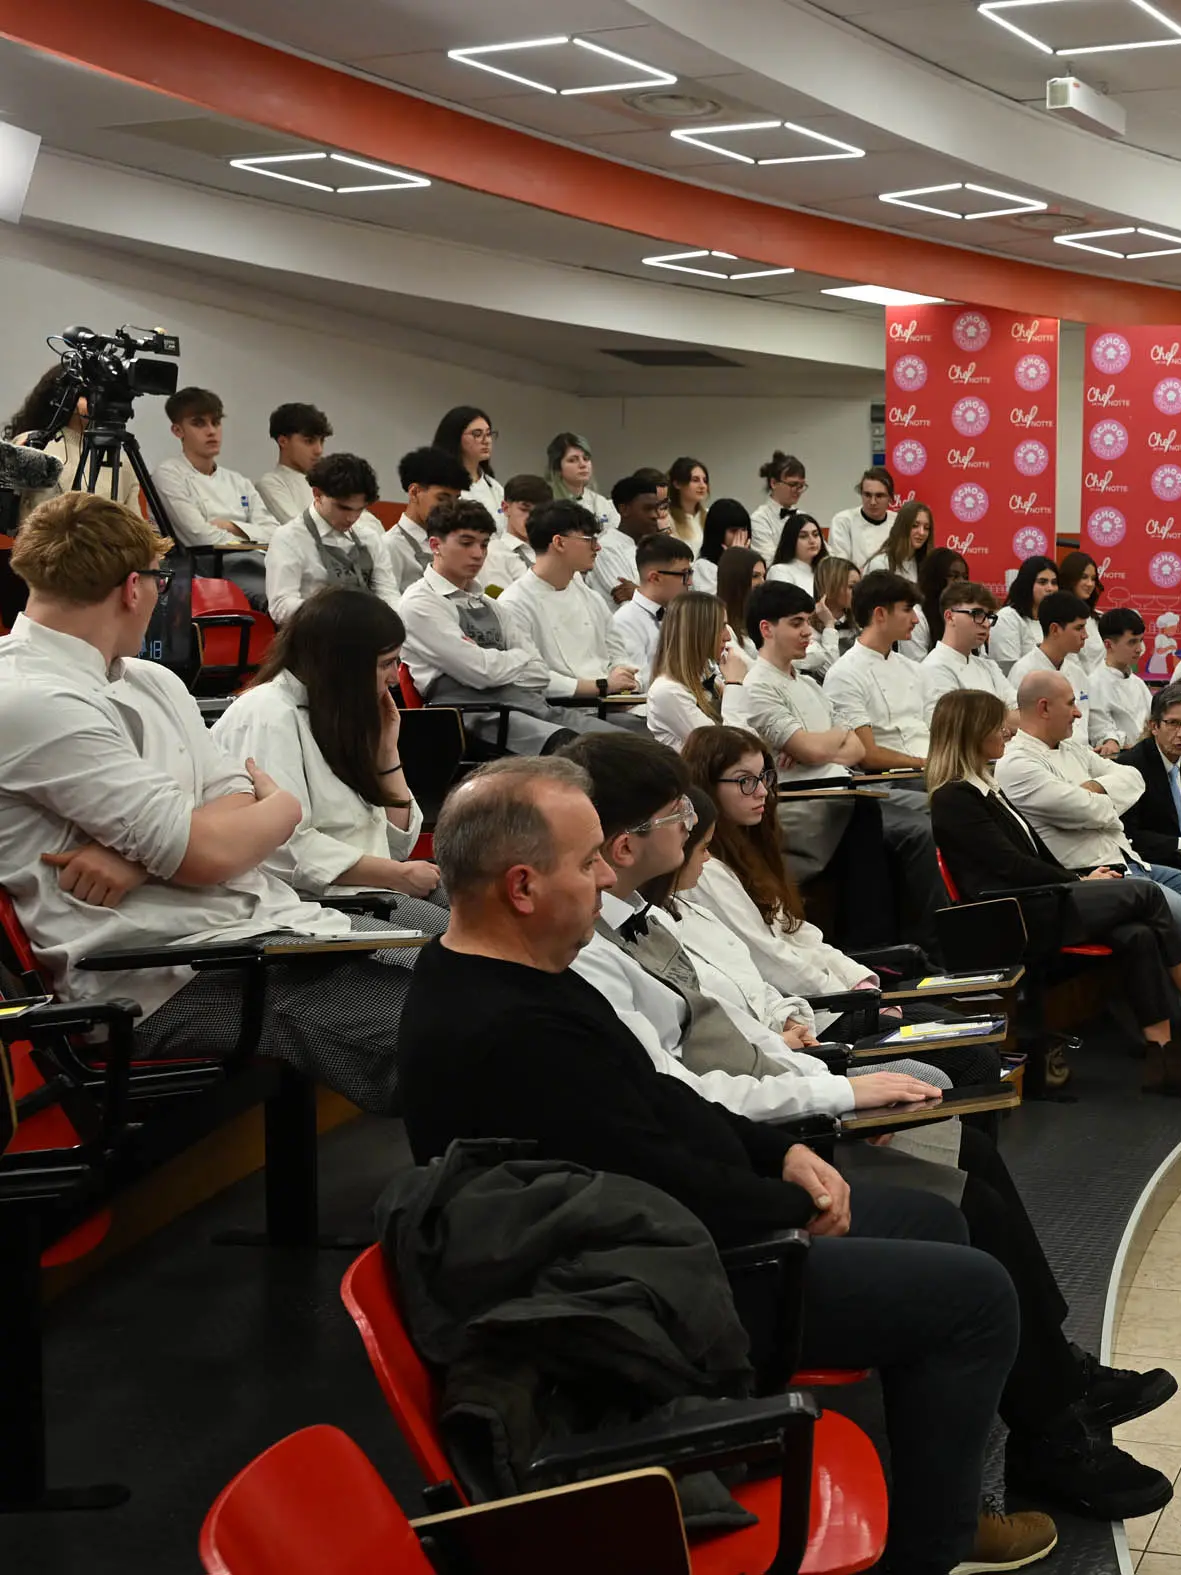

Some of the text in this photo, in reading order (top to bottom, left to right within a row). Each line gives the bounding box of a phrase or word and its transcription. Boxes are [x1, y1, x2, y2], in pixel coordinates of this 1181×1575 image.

[890, 320, 917, 343] Chef
[956, 315, 987, 333] SCHOOL
[1011, 320, 1039, 343] Chef
[1095, 337, 1128, 355] SCHOOL
[1151, 342, 1179, 366] Chef
[896, 358, 925, 375] SCHOOL
[949, 362, 976, 384] Chef
[1018, 358, 1047, 374] SCHOOL
[1087, 384, 1115, 407] Chef
[889, 405, 916, 427] Chef
[955, 400, 987, 418] SCHOOL
[1010, 405, 1038, 428] Chef
[1093, 423, 1125, 442] SCHOOL
[1148, 429, 1176, 452] Chef
[896, 442, 924, 459] SCHOOL
[947, 447, 975, 470] Chef
[1017, 443, 1046, 460] SCHOOL
[1085, 470, 1113, 493] Chef
[954, 486, 985, 504] SCHOOL
[1009, 492, 1037, 515] Chef
[1091, 510, 1123, 529] SCHOOL
[1146, 517, 1174, 540] Chef
[946, 532, 974, 555] Chef
[1015, 529, 1045, 546] SCHOOL
[1152, 554, 1181, 571] SCHOOL
